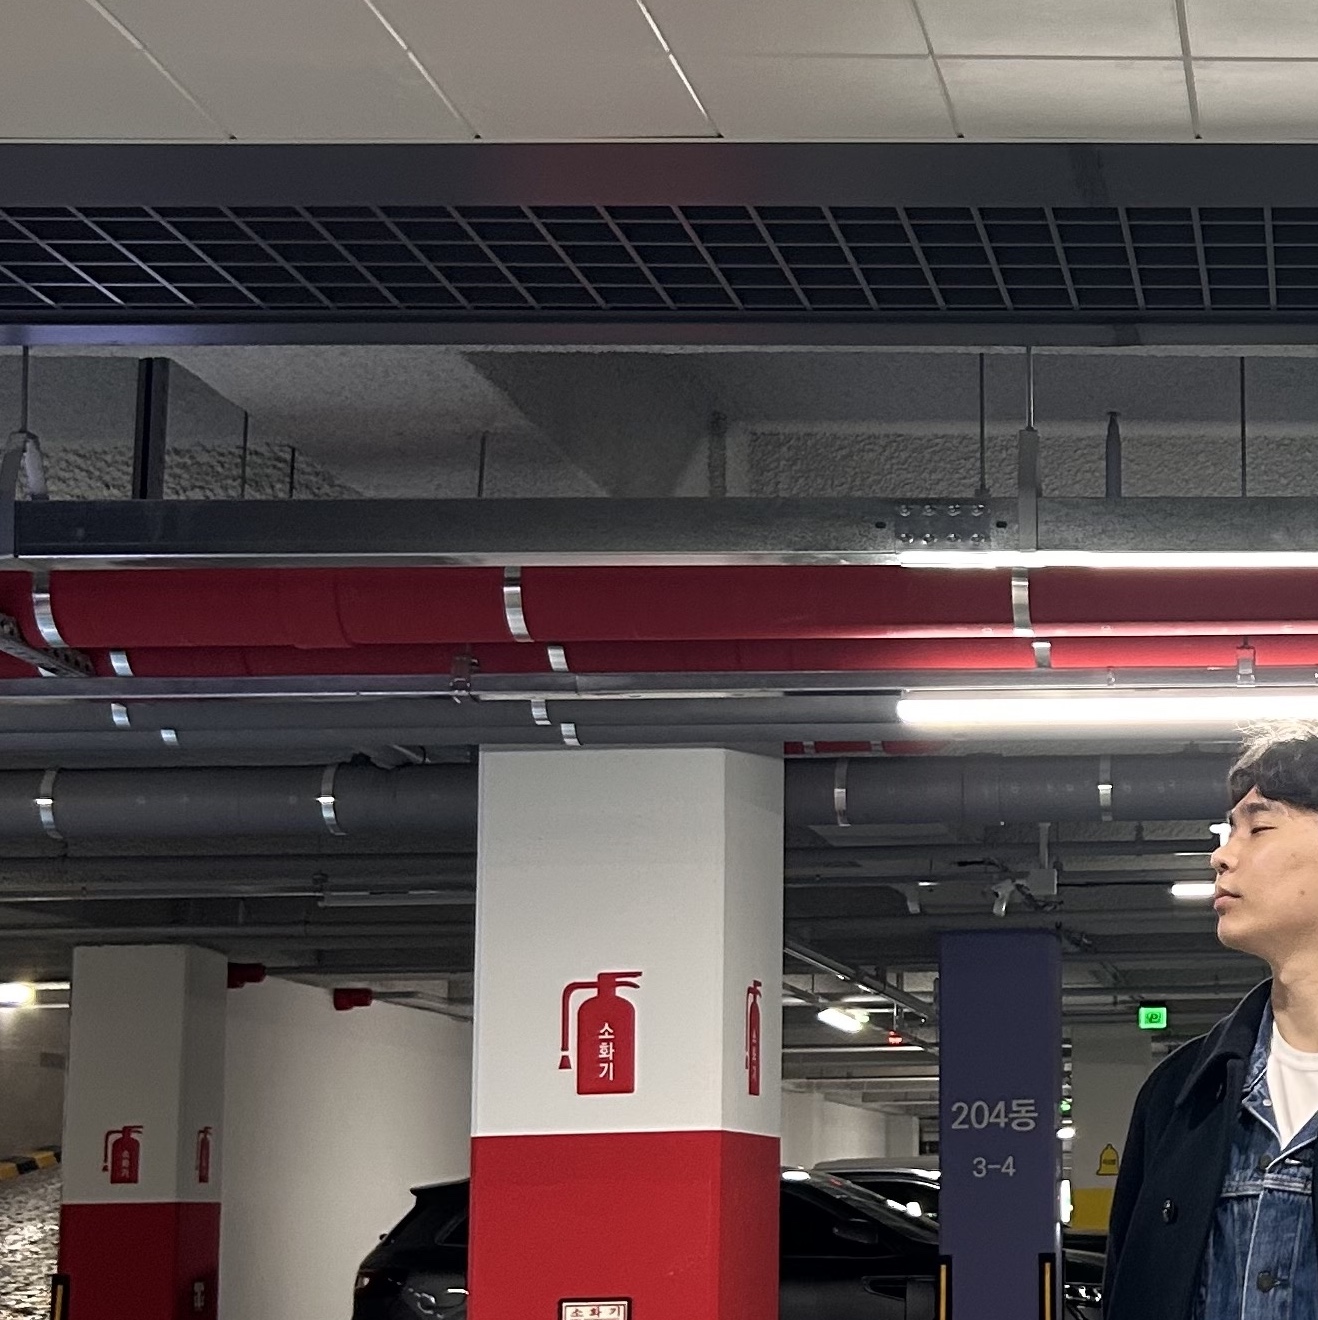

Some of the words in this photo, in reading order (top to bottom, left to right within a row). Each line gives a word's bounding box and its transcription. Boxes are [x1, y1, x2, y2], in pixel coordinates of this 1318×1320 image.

[598, 1022, 616, 1082] 소화기
[951, 1099, 1039, 1131] 204동
[972, 1155, 1017, 1178] 3-4
